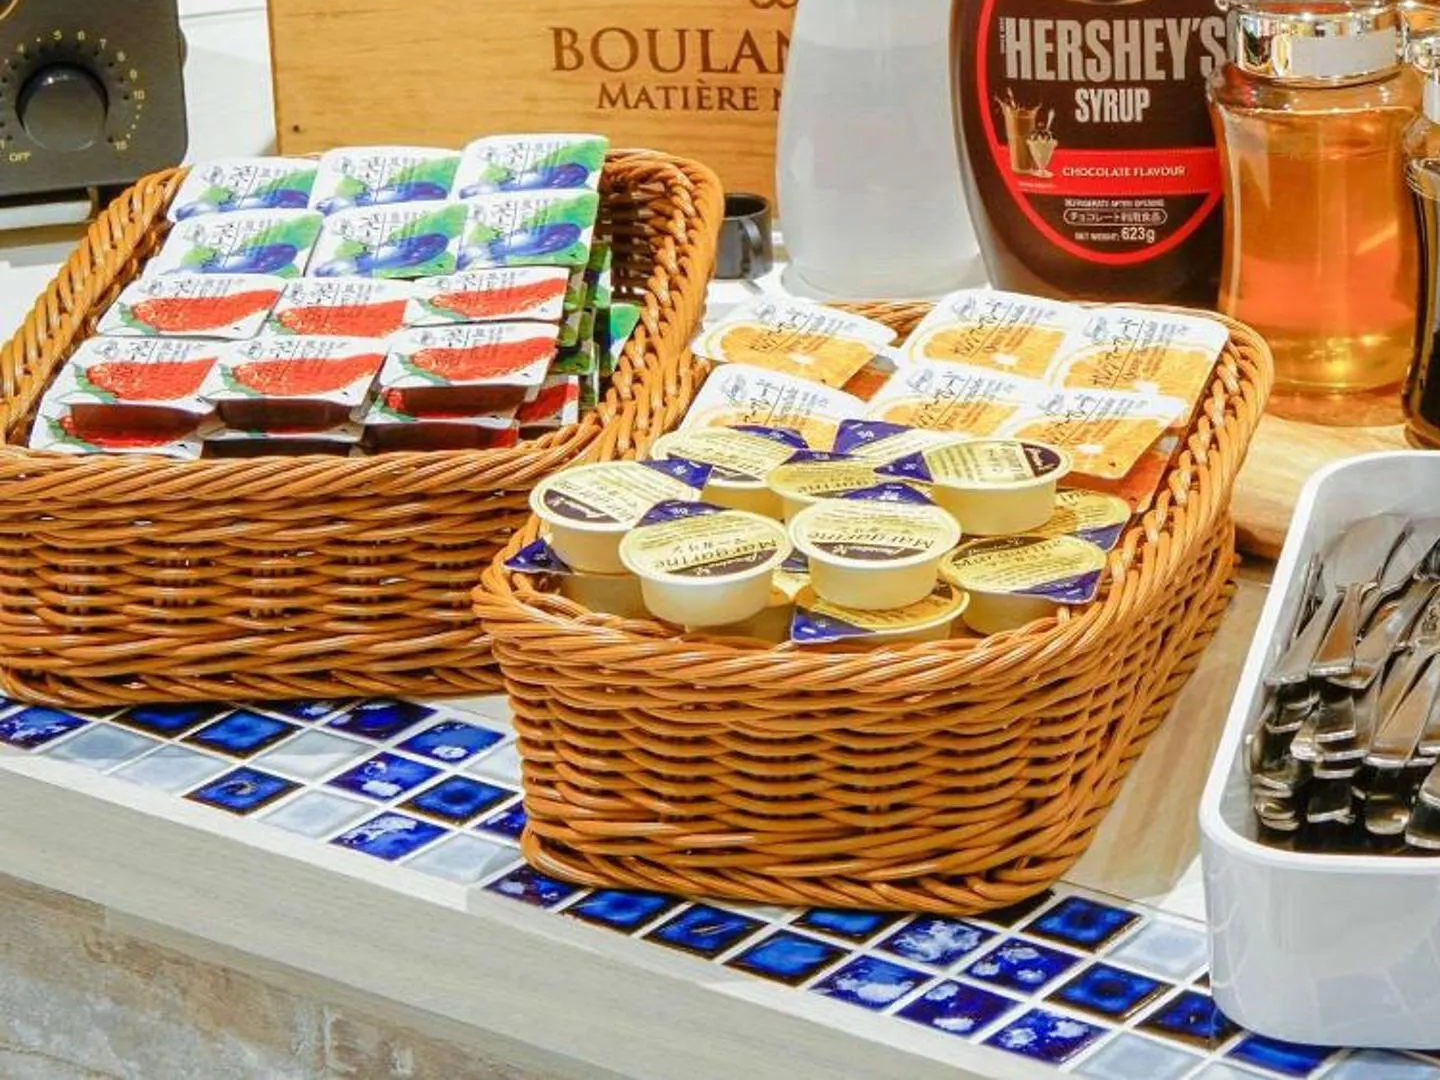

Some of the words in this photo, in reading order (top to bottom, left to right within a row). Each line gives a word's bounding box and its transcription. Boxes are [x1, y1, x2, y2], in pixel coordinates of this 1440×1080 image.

[1004, 16, 1226, 83] HERSHEY'S
[597, 78, 760, 112] MATIÈRE
[1074, 87, 1150, 123] SYRUP
[9, 152, 31, 162] OFF
[1062, 166, 1131, 178] CHOCOLATE
[1133, 166, 1186, 178] FLAVOUR
